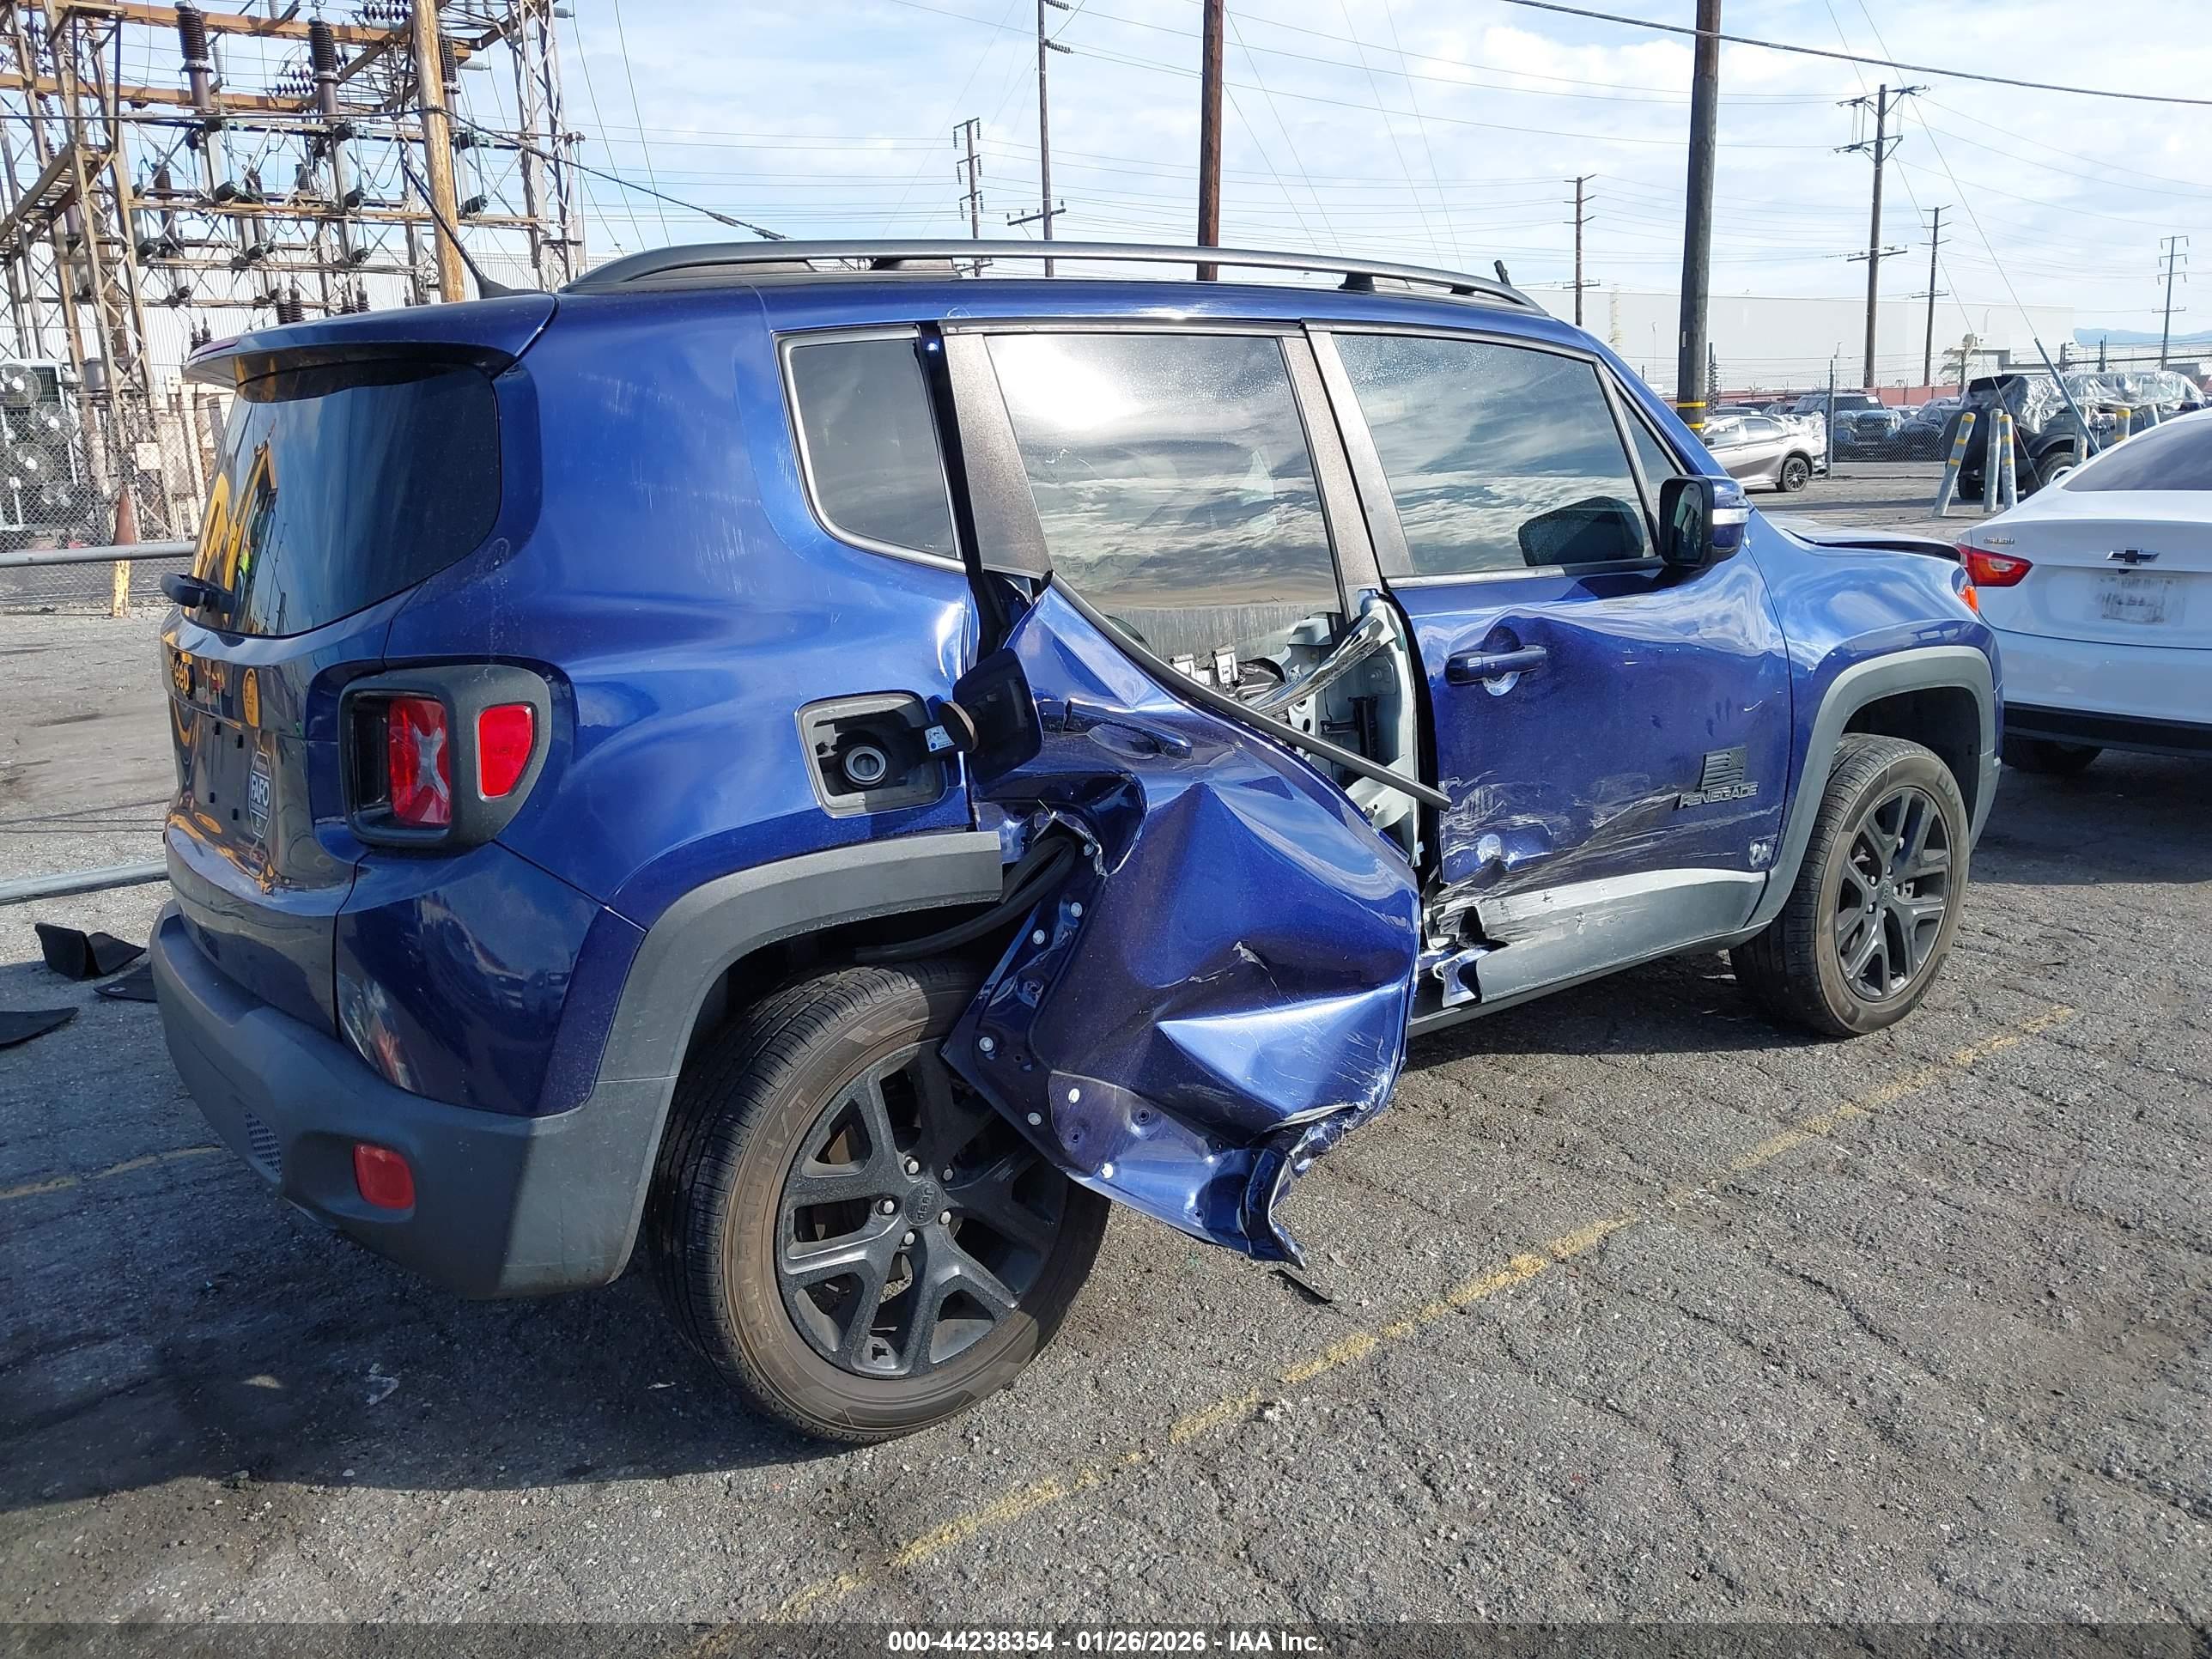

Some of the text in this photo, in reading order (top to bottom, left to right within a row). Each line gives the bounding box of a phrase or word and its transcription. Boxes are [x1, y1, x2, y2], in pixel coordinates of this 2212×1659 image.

[251, 774, 270, 807] FAFO
[1679, 782, 1759, 808] RENEGADE
[916, 1187, 935, 1220] Jeep
